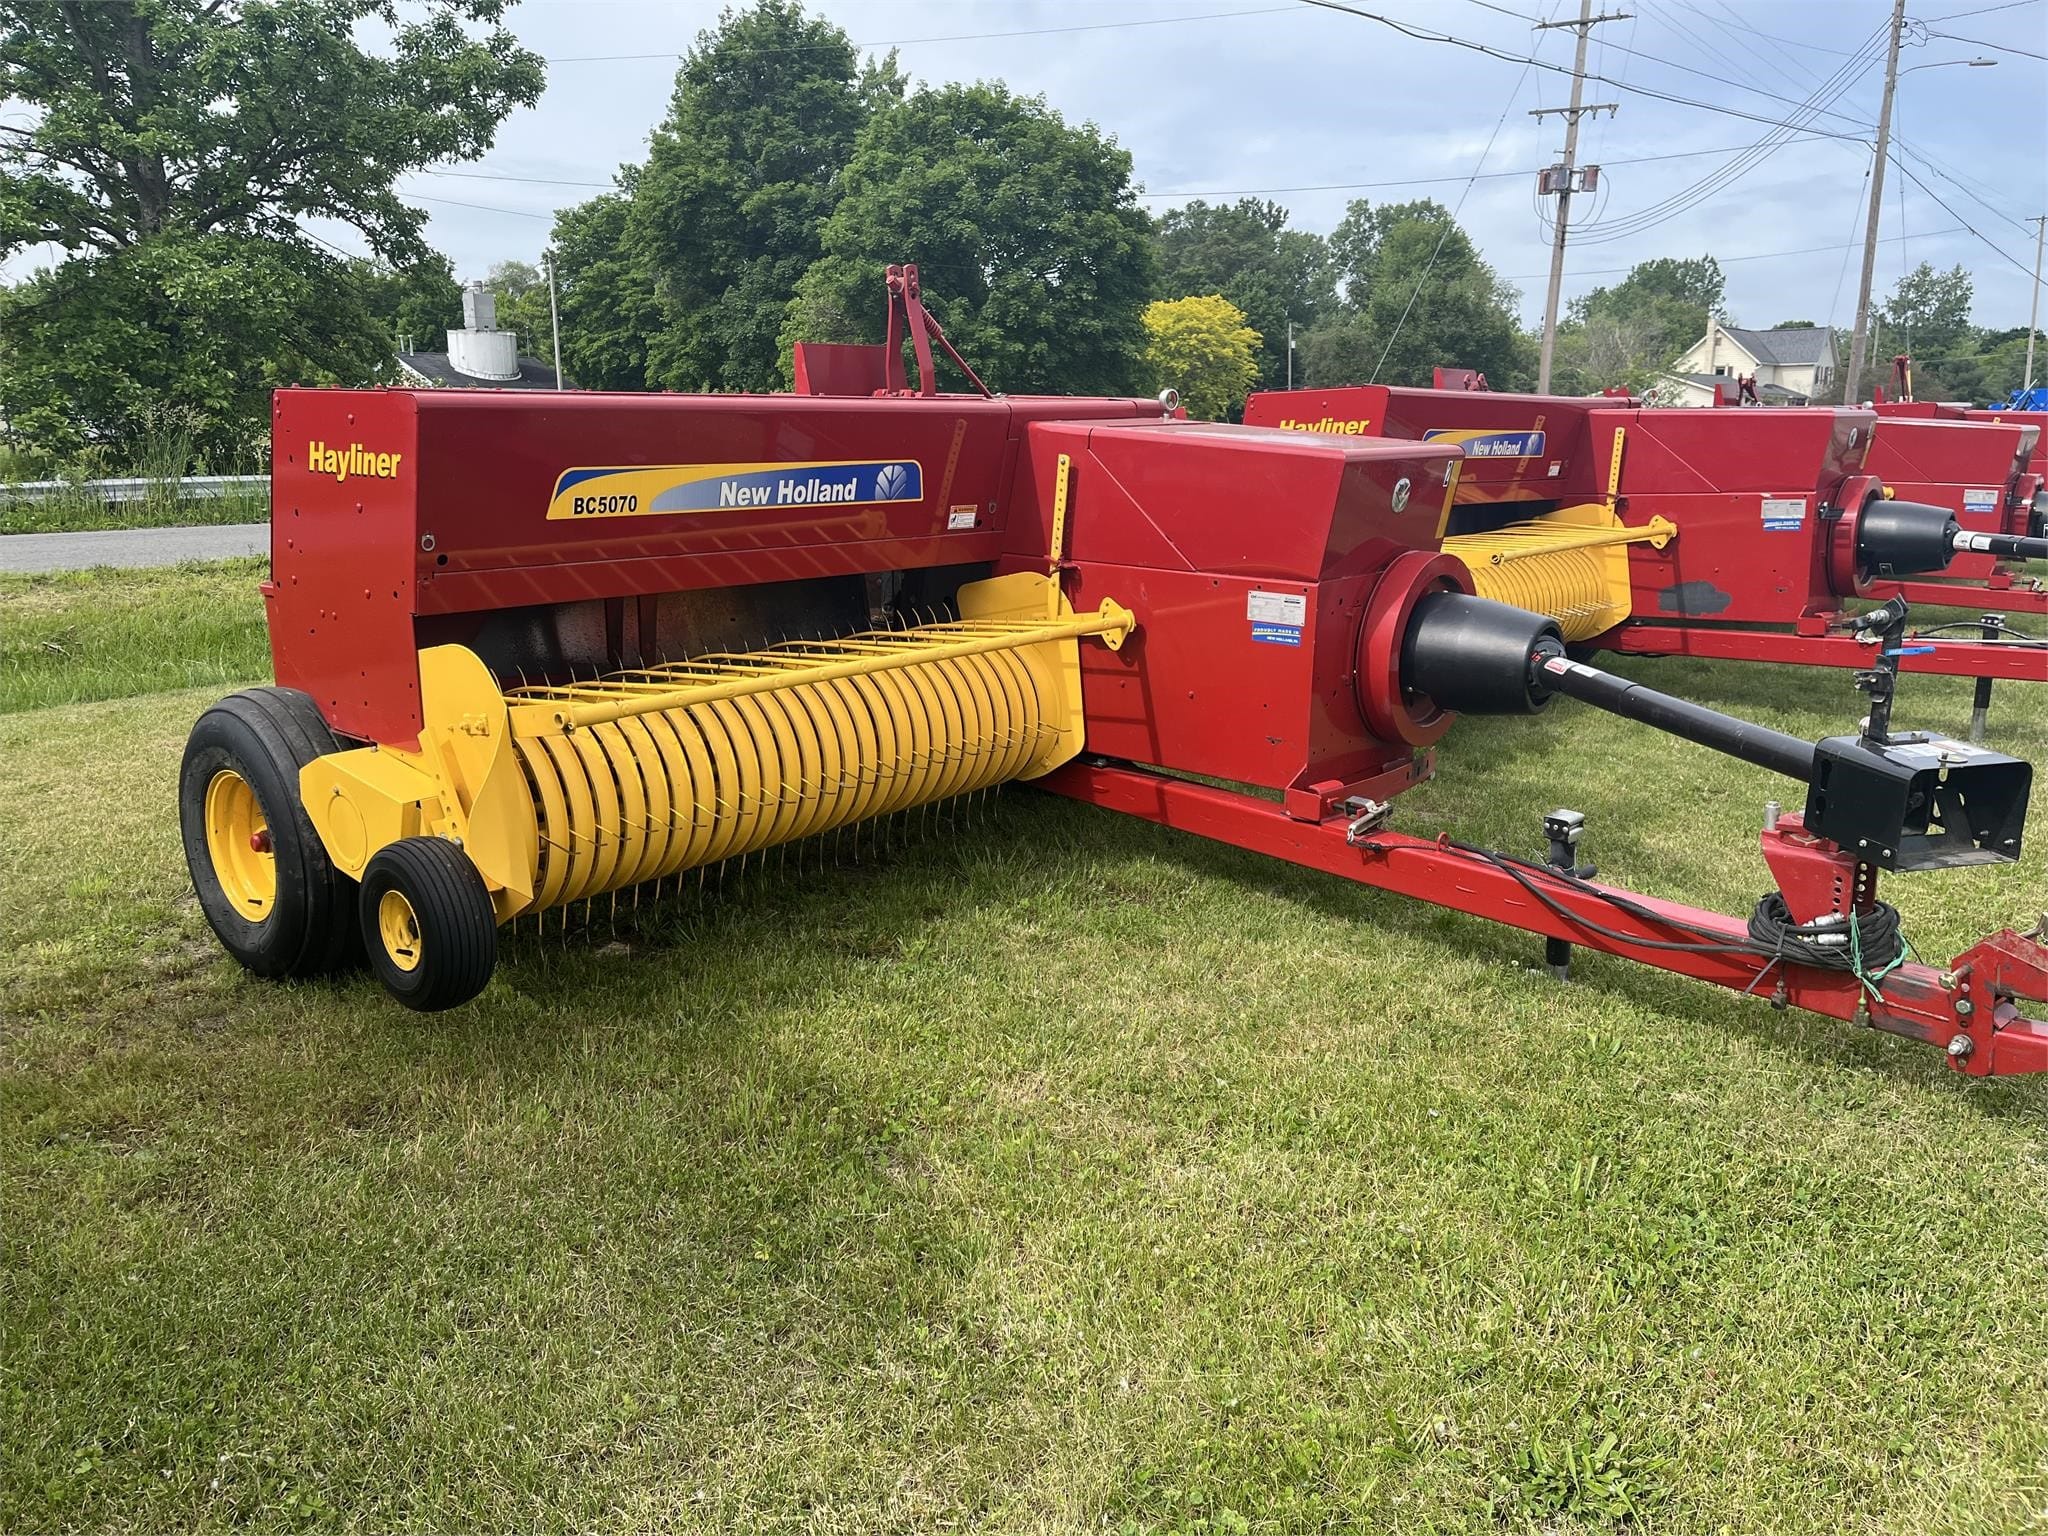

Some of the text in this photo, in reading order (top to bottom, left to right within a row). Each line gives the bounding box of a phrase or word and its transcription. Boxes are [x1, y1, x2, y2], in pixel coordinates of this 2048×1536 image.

[1472, 440, 1522, 456] New Holland
[308, 440, 402, 483] Hayliner
[719, 478, 857, 507] New Holland
[573, 495, 638, 515] BC5070
